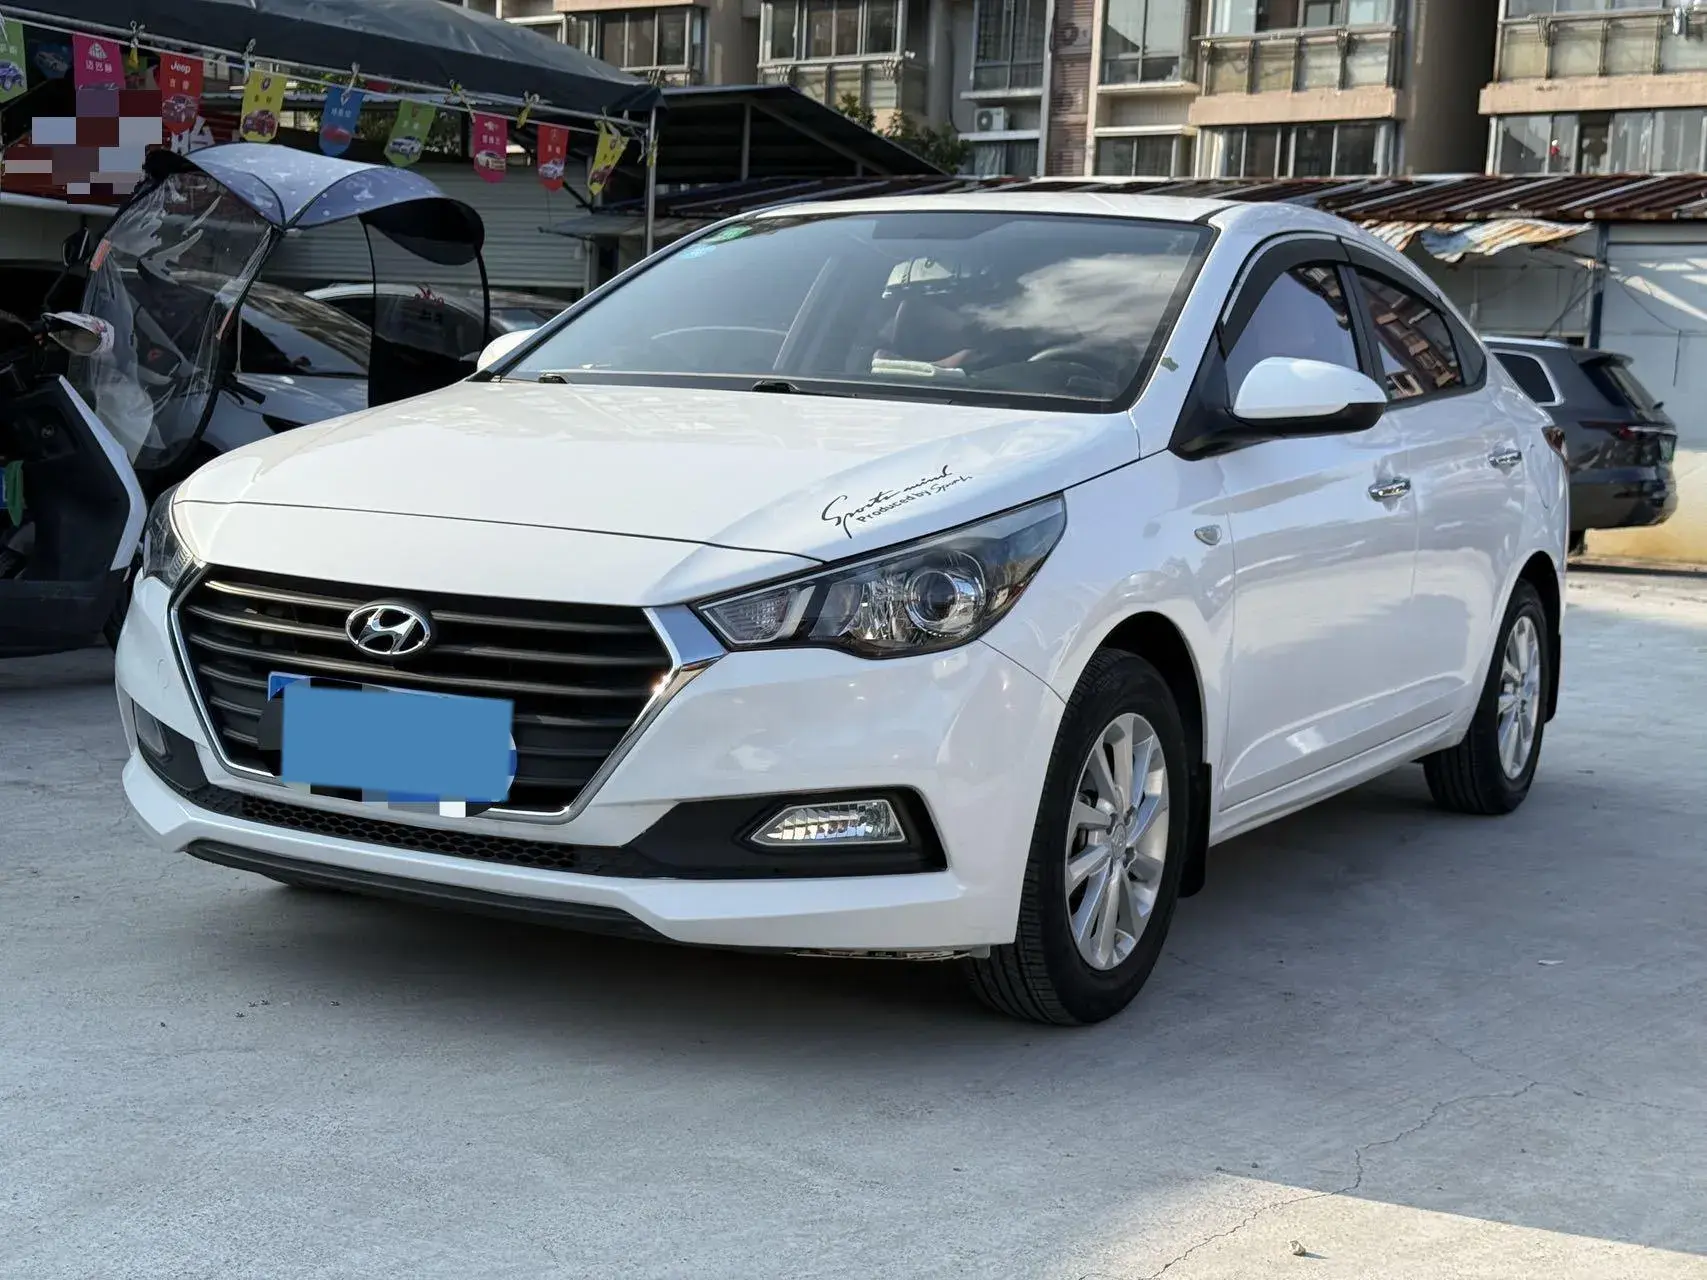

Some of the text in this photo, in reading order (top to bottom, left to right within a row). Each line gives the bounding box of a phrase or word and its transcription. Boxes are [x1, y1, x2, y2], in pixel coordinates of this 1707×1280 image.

[170, 61, 191, 75] Jeep
[856, 494, 916, 523] Produced
[914, 490, 932, 499] by
